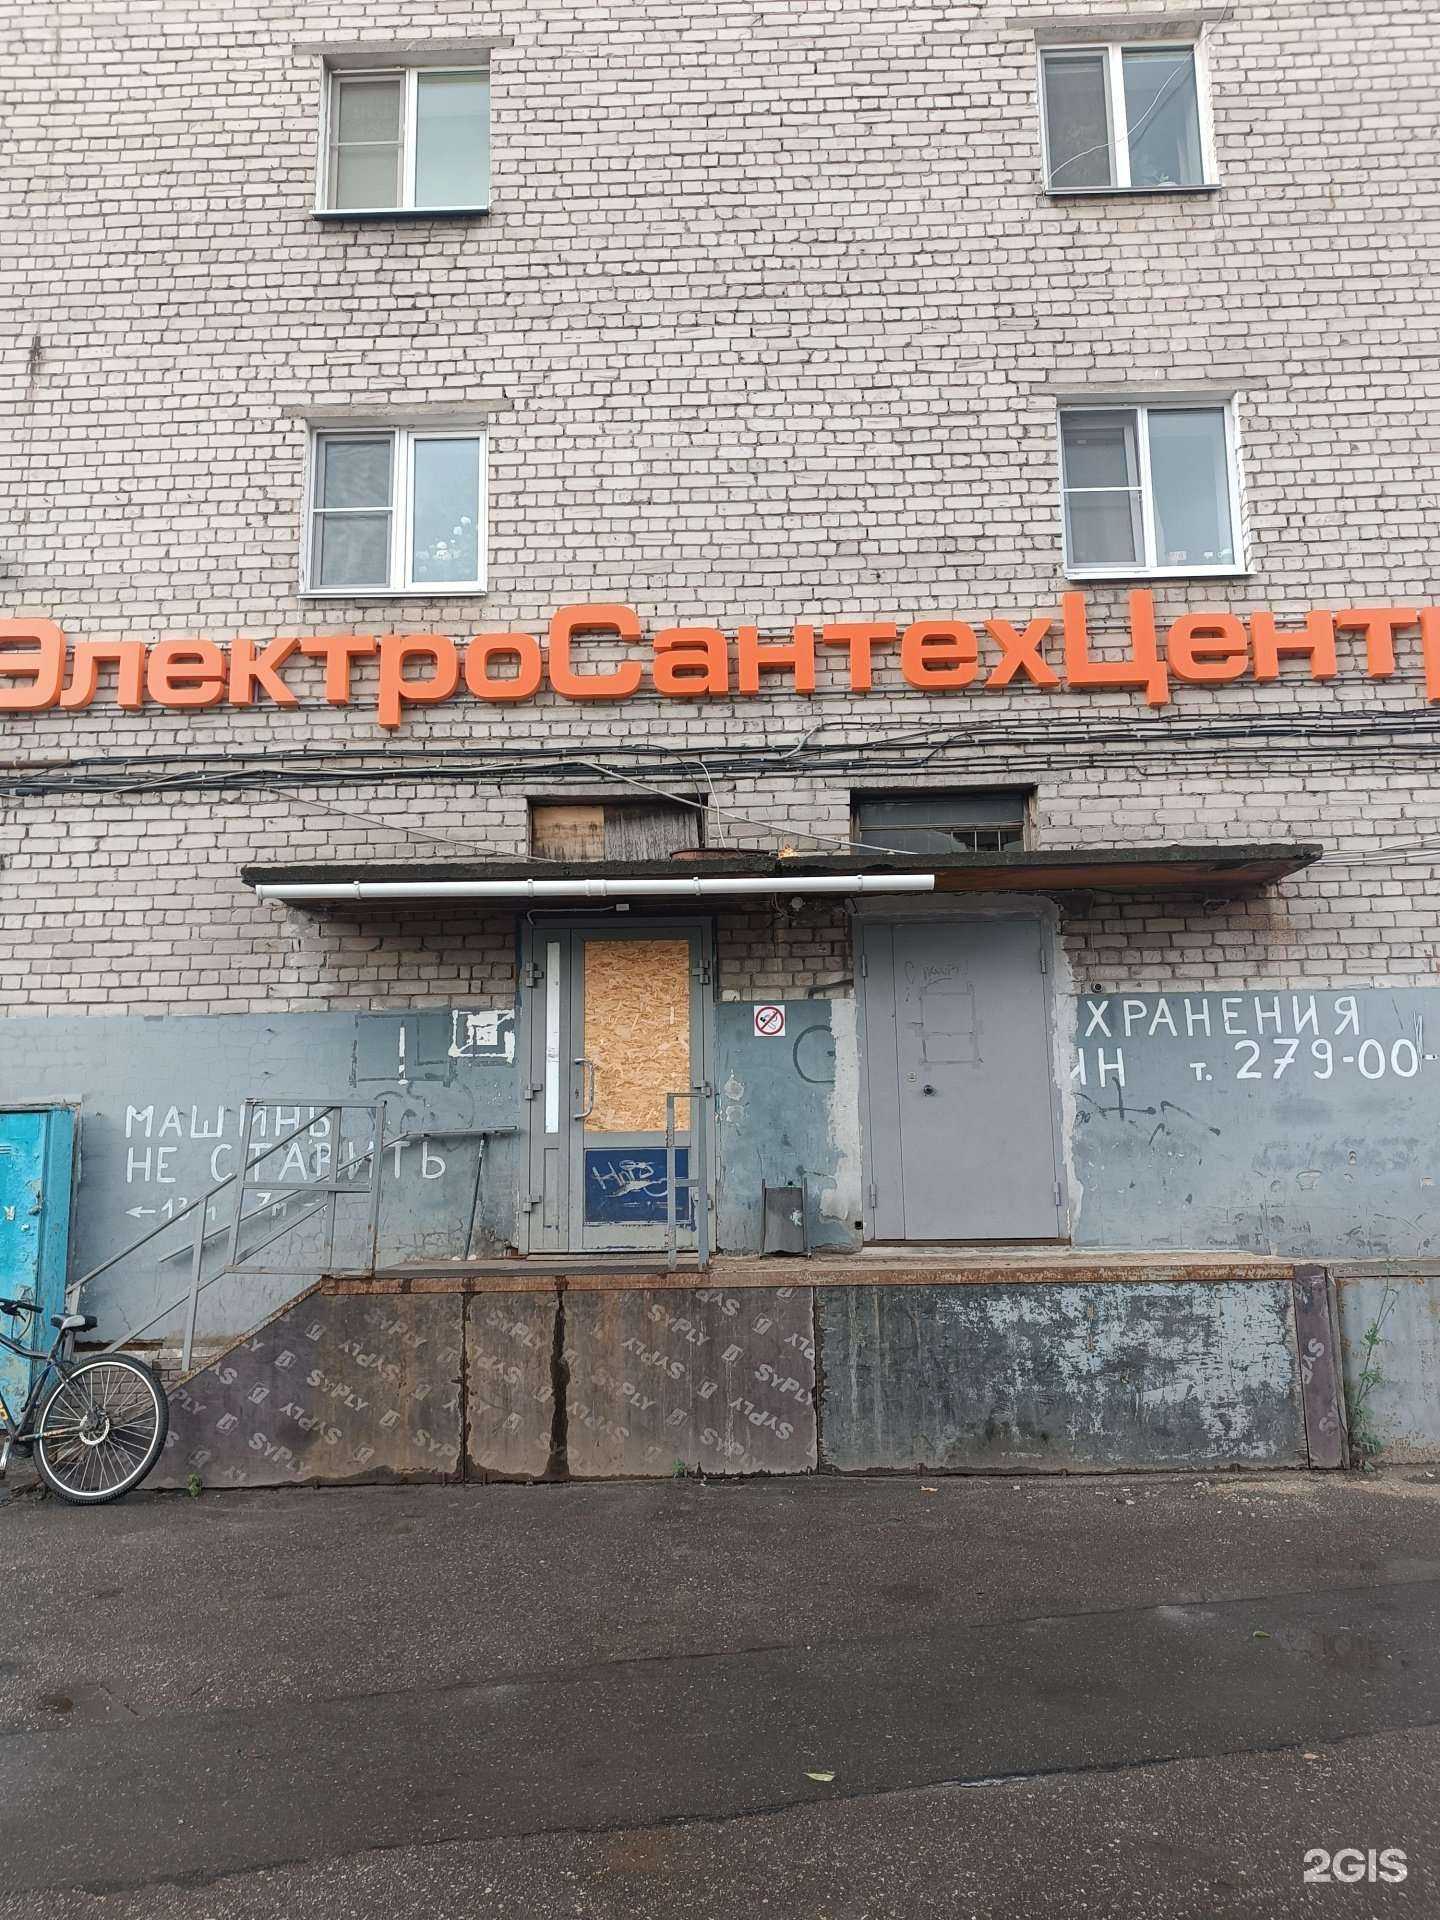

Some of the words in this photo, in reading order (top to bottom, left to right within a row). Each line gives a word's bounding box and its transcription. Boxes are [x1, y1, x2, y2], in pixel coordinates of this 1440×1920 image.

[0, 588, 1440, 729] ЭлектроСантехЦент
[1085, 996, 1360, 1037] ХРАНЕНИЯ
[126, 1146, 178, 1183] НЕ
